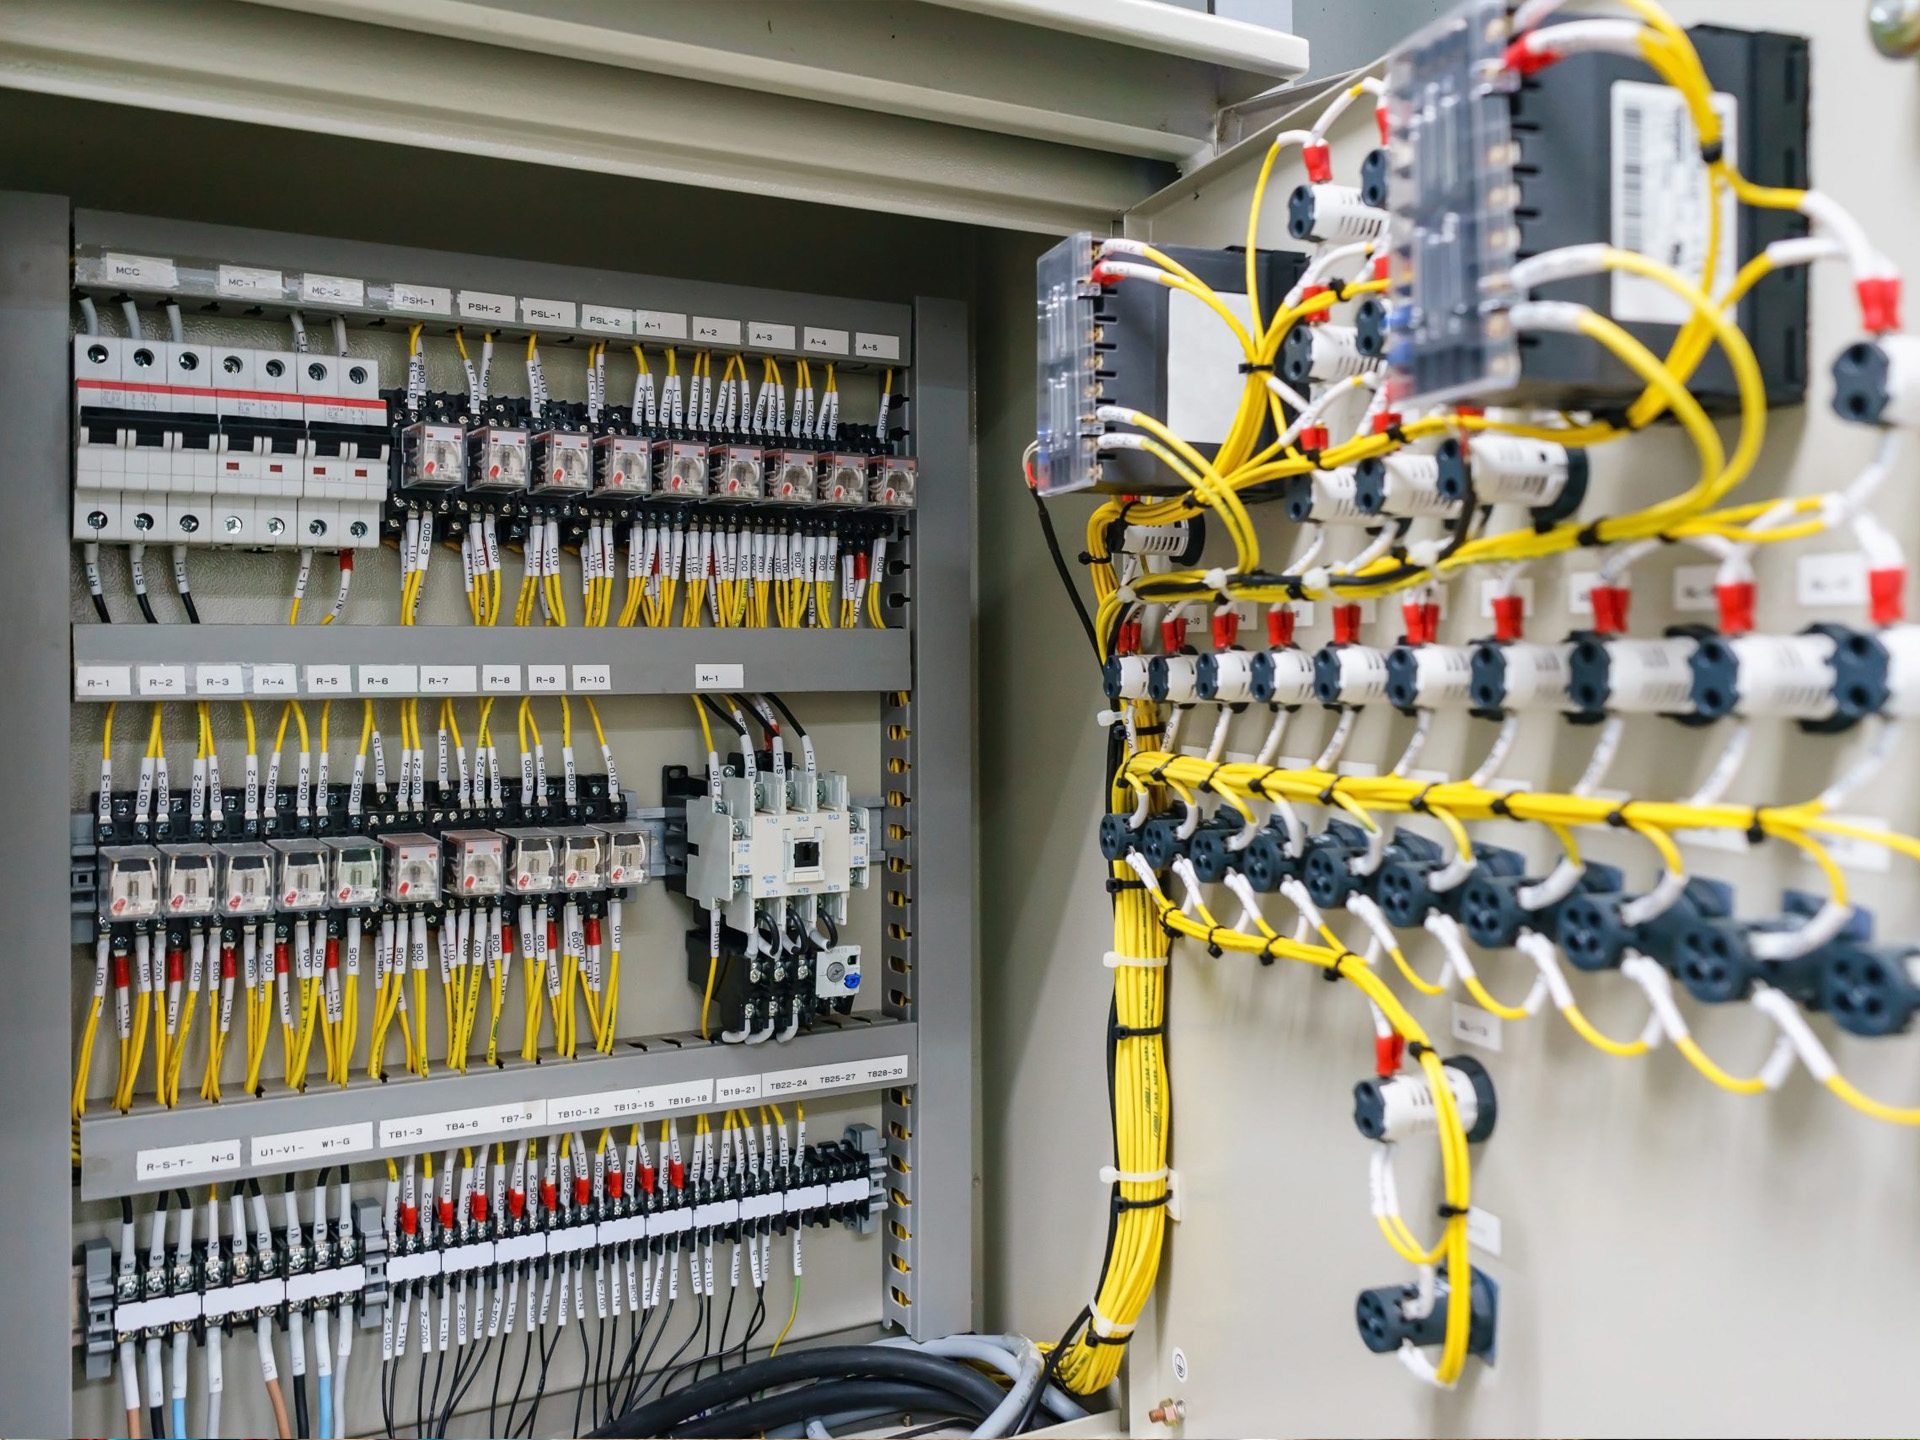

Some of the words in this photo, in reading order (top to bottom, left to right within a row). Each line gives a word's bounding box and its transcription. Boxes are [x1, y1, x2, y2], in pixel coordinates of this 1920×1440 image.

[116, 266, 140, 276] MCC
[228, 278, 257, 288] MC-1
[312, 286, 341, 297] MC-2
[402, 295, 435, 306] PSH-1
[468, 302, 501, 313] PSH-2
[531, 309, 561, 319] PSL-1
[590, 316, 621, 327] PSL-2
[644, 321, 661, 330] A-1
[700, 328, 717, 336] A-2
[755, 333, 773, 342] A-3
[810, 337, 827, 346] A-4
[862, 343, 878, 352] A-5
[409, 361, 418, 399] 011-13
[537, 364, 547, 393] 010-1
[637, 386, 645, 417] 011-7
[646, 385, 655, 416] 011-5
[663, 388, 673, 418] 011-3
[674, 389, 682, 417] 011-1
[756, 394, 767, 422] 003-1
[420, 522, 431, 556] 008-3
[89, 561, 100, 588] R1-1
[133, 561, 145, 587] S1-1
[176, 561, 185, 586] T1-1
[298, 566, 309, 592] L1-1
[87, 679, 110, 688] R-1
[149, 678, 173, 687] R-2
[206, 678, 230, 686] R-3
[262, 677, 285, 686] R-4
[316, 677, 338, 685] R-5
[367, 677, 389, 685] R-6
[428, 677, 449, 685] R-7
[490, 676, 510, 684] R-8
[536, 676, 556, 684] R-9
[580, 675, 605, 684] R-10
[702, 674, 719, 682] M-1
[747, 753, 755, 777] R1-1
[776, 752, 784, 775] S1-1
[807, 750, 815, 773] T1-1
[211, 768, 221, 803] 003-3
[248, 769, 257, 804] 003-2
[267, 765, 278, 799] 004-3
[300, 767, 309, 801] 004-2
[318, 765, 328, 799] 005-3
[352, 769, 364, 803] 005-2
[476, 756, 485, 793] 007-2+
[524, 759, 533, 792] 008-3
[713, 770, 721, 787] 010
[101, 774, 111, 810] 001-3
[138, 773, 151, 808] 001-2
[157, 771, 168, 807] 002-3
[193, 774, 202, 808] 002-2
[416, 943, 424, 962] 006
[474, 939, 482, 958] 007
[524, 932, 532, 952] 008
[537, 934, 545, 953] 009
[265, 953, 273, 973] 004
[315, 948, 324, 969] 005
[349, 947, 357, 967] 005
[96, 967, 105, 986] 001
[193, 961, 202, 982] 002
[212, 961, 220, 980] 003
[550, 964, 560, 988] N1-1
[167, 1000, 177, 1026] N1-1
[224, 999, 232, 1023] N1-1
[333, 989, 342, 1013] N1-1
[770, 1079, 808, 1090] TB22-24
[819, 1073, 856, 1084] TB25-27
[867, 1067, 903, 1078] TB28-30
[558, 1106, 600, 1119] TB10-12
[614, 1099, 655, 1112] TB13-15
[668, 1094, 707, 1106] TB16-18
[388, 1127, 423, 1139] TB1-3
[445, 1120, 479, 1131] TB4-6
[500, 1112, 533, 1124] TB7-9
[260, 1145, 304, 1157] U1-V1-
[321, 1137, 350, 1149] W1-G
[610, 1147, 620, 1171] N1-1
[640, 1143, 652, 1166] N1-1
[672, 1138, 680, 1162] N1-1
[722, 1142, 730, 1173] 011-3
[749, 1139, 757, 1168] 011-5
[780, 1137, 789, 1165] 011-7
[147, 1159, 193, 1171] R-S-T-
[211, 1153, 234, 1163] N-G
[693, 1150, 702, 1179] 011-1
[626, 1160, 634, 1190] 008-4
[424, 1193, 432, 1223] 002-2
[464, 1183, 472, 1214] 003-2
[259, 1232, 267, 1243] U1
[291, 1227, 299, 1238] V1
[691, 1259, 701, 1287] 011-1
[577, 1287, 585, 1310] N1-1
[458, 1303, 466, 1336] 003-2
[489, 1297, 501, 1329] 004-2
[384, 1317, 392, 1350] 001-2
[398, 1322, 408, 1348] N1-1
[421, 1311, 429, 1344] 002-2
